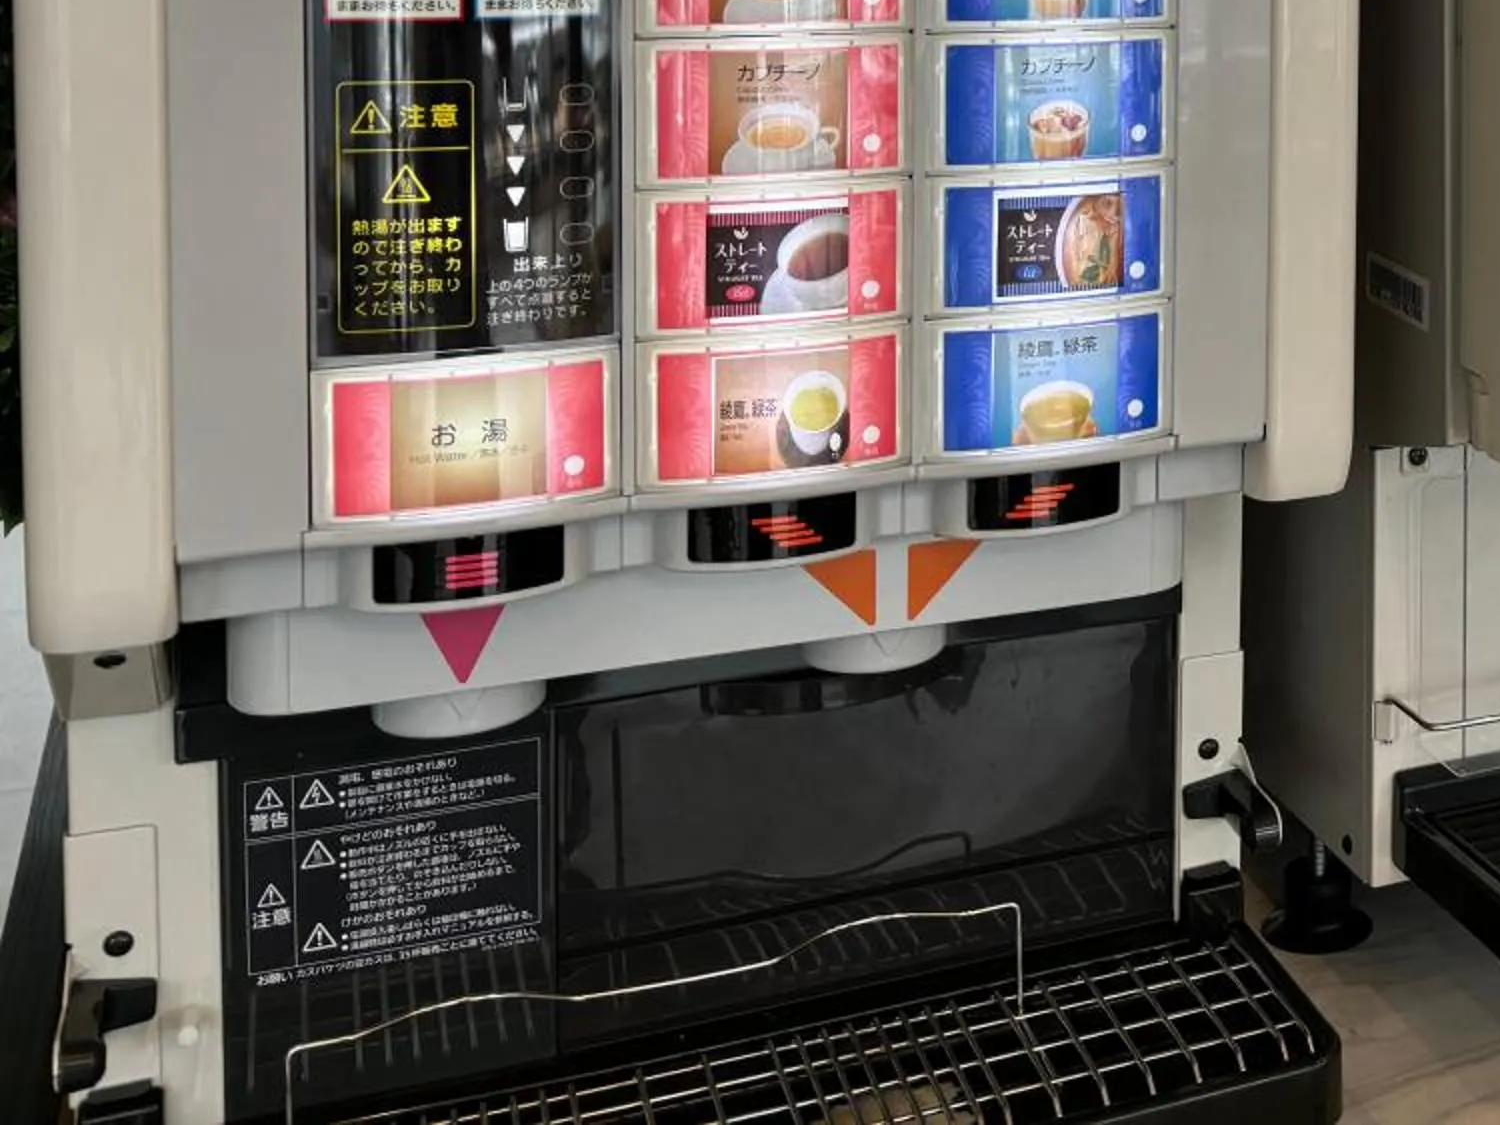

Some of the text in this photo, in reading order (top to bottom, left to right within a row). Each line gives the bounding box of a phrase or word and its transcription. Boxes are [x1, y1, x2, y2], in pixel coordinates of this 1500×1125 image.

[400, 103, 458, 128] 注意
[352, 216, 462, 236] 熱湯が出ます
[1007, 223, 1053, 239] ストレート
[352, 237, 462, 257] ので注ぎ終わ
[716, 241, 767, 258] ストレート
[1015, 240, 1046, 254] ティー
[513, 253, 583, 273] 出来上り
[724, 259, 758, 274] ティー
[354, 278, 461, 296] ップをお取り
[355, 299, 435, 316] ください。
[431, 418, 508, 448] お湯
[250, 812, 288, 832] 警告
[252, 907, 291, 929] 注意
